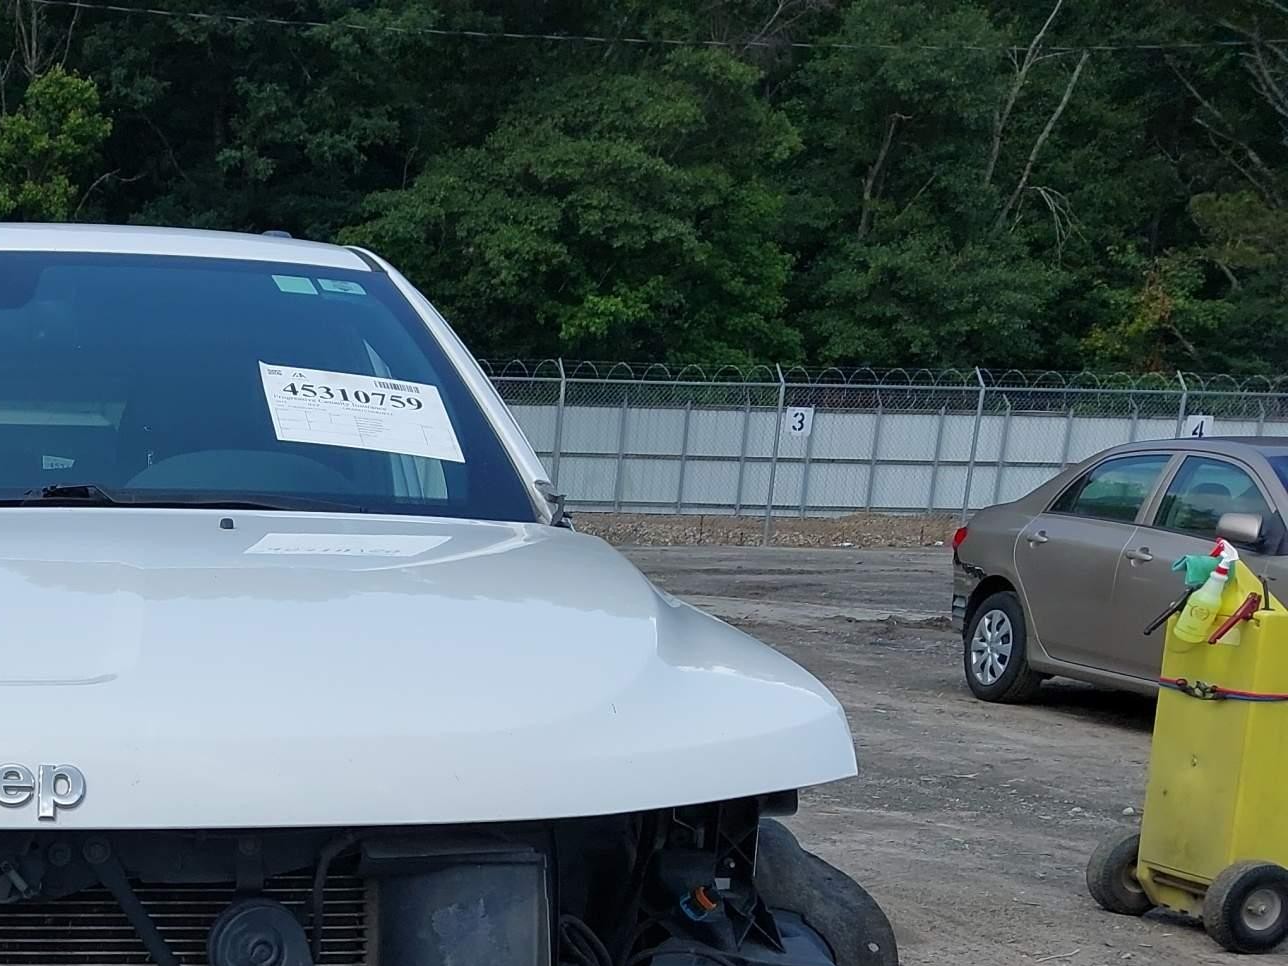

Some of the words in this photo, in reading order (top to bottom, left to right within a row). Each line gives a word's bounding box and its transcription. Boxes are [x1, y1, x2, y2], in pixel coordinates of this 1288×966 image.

[282, 382, 423, 411] 45310759
[792, 412, 805, 432] 3
[1192, 420, 1204, 438] 4
